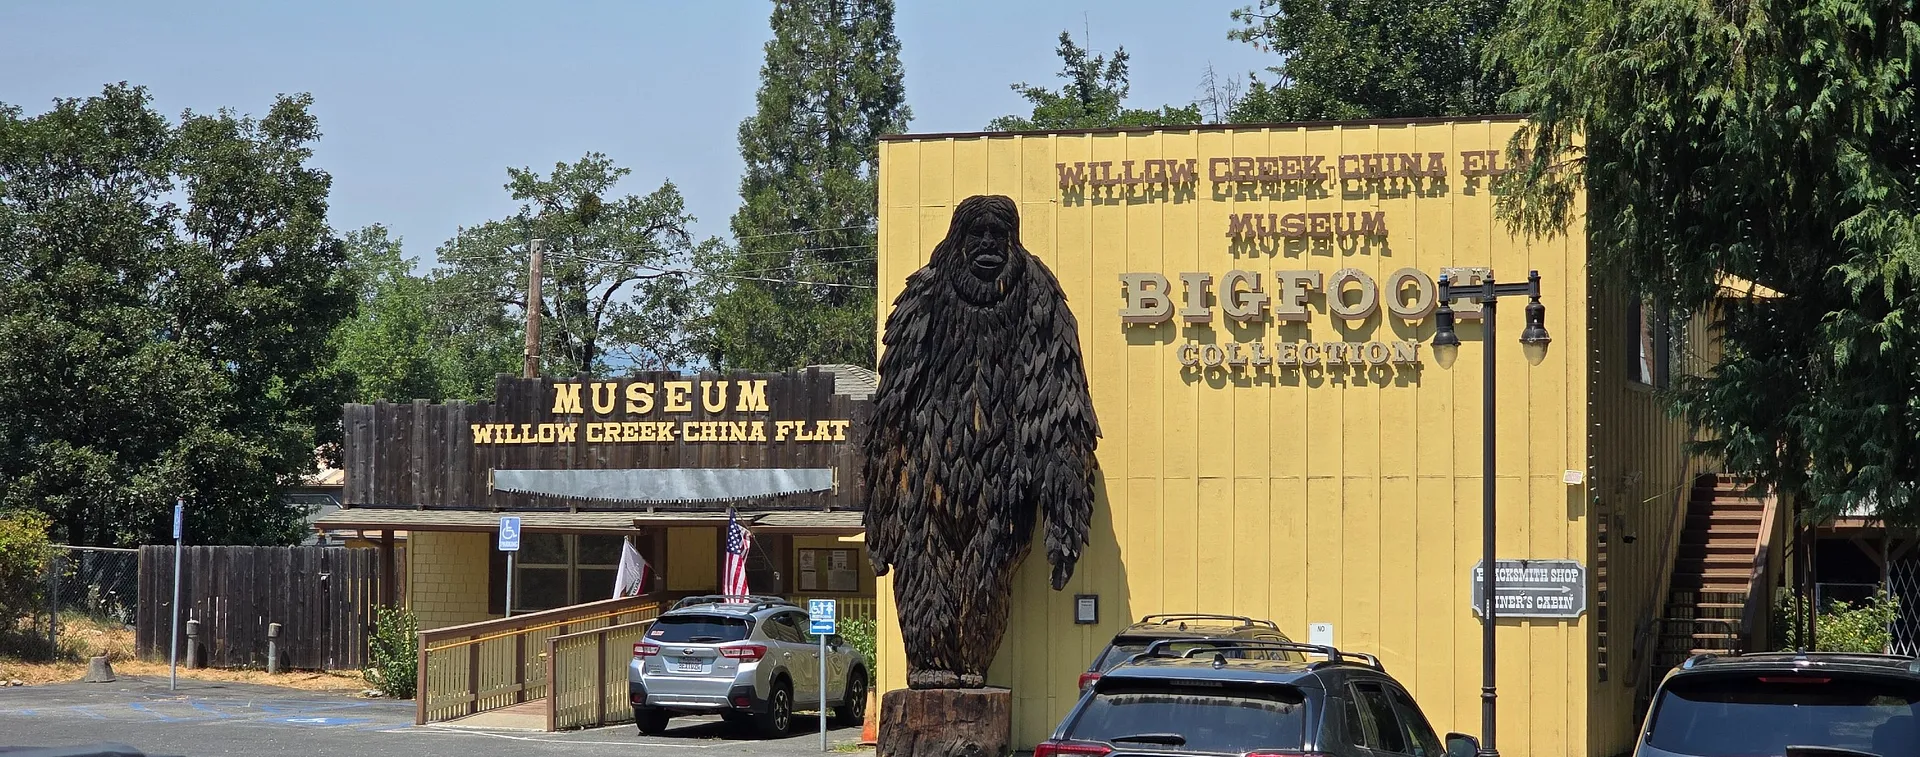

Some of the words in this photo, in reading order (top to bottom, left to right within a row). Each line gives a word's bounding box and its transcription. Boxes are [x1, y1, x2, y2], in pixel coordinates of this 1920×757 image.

[1056, 158, 1198, 187] WILLOW
[1226, 211, 1389, 238] MUSEUM
[1118, 267, 1493, 322] BIGFOOT
[1177, 342, 1420, 367] COLLECTION
[551, 380, 770, 415] MUSEUM
[471, 422, 578, 444] WILLOW
[586, 421, 767, 443] CREEK-CHINA
[774, 420, 850, 441] FLAT
[1476, 568, 1549, 583] BACKSMITH
[1550, 568, 1580, 583] SHOP
[1494, 595, 1534, 609] INER'S
[1536, 596, 1574, 609] CABIN
[1317, 625, 1326, 633] NO
